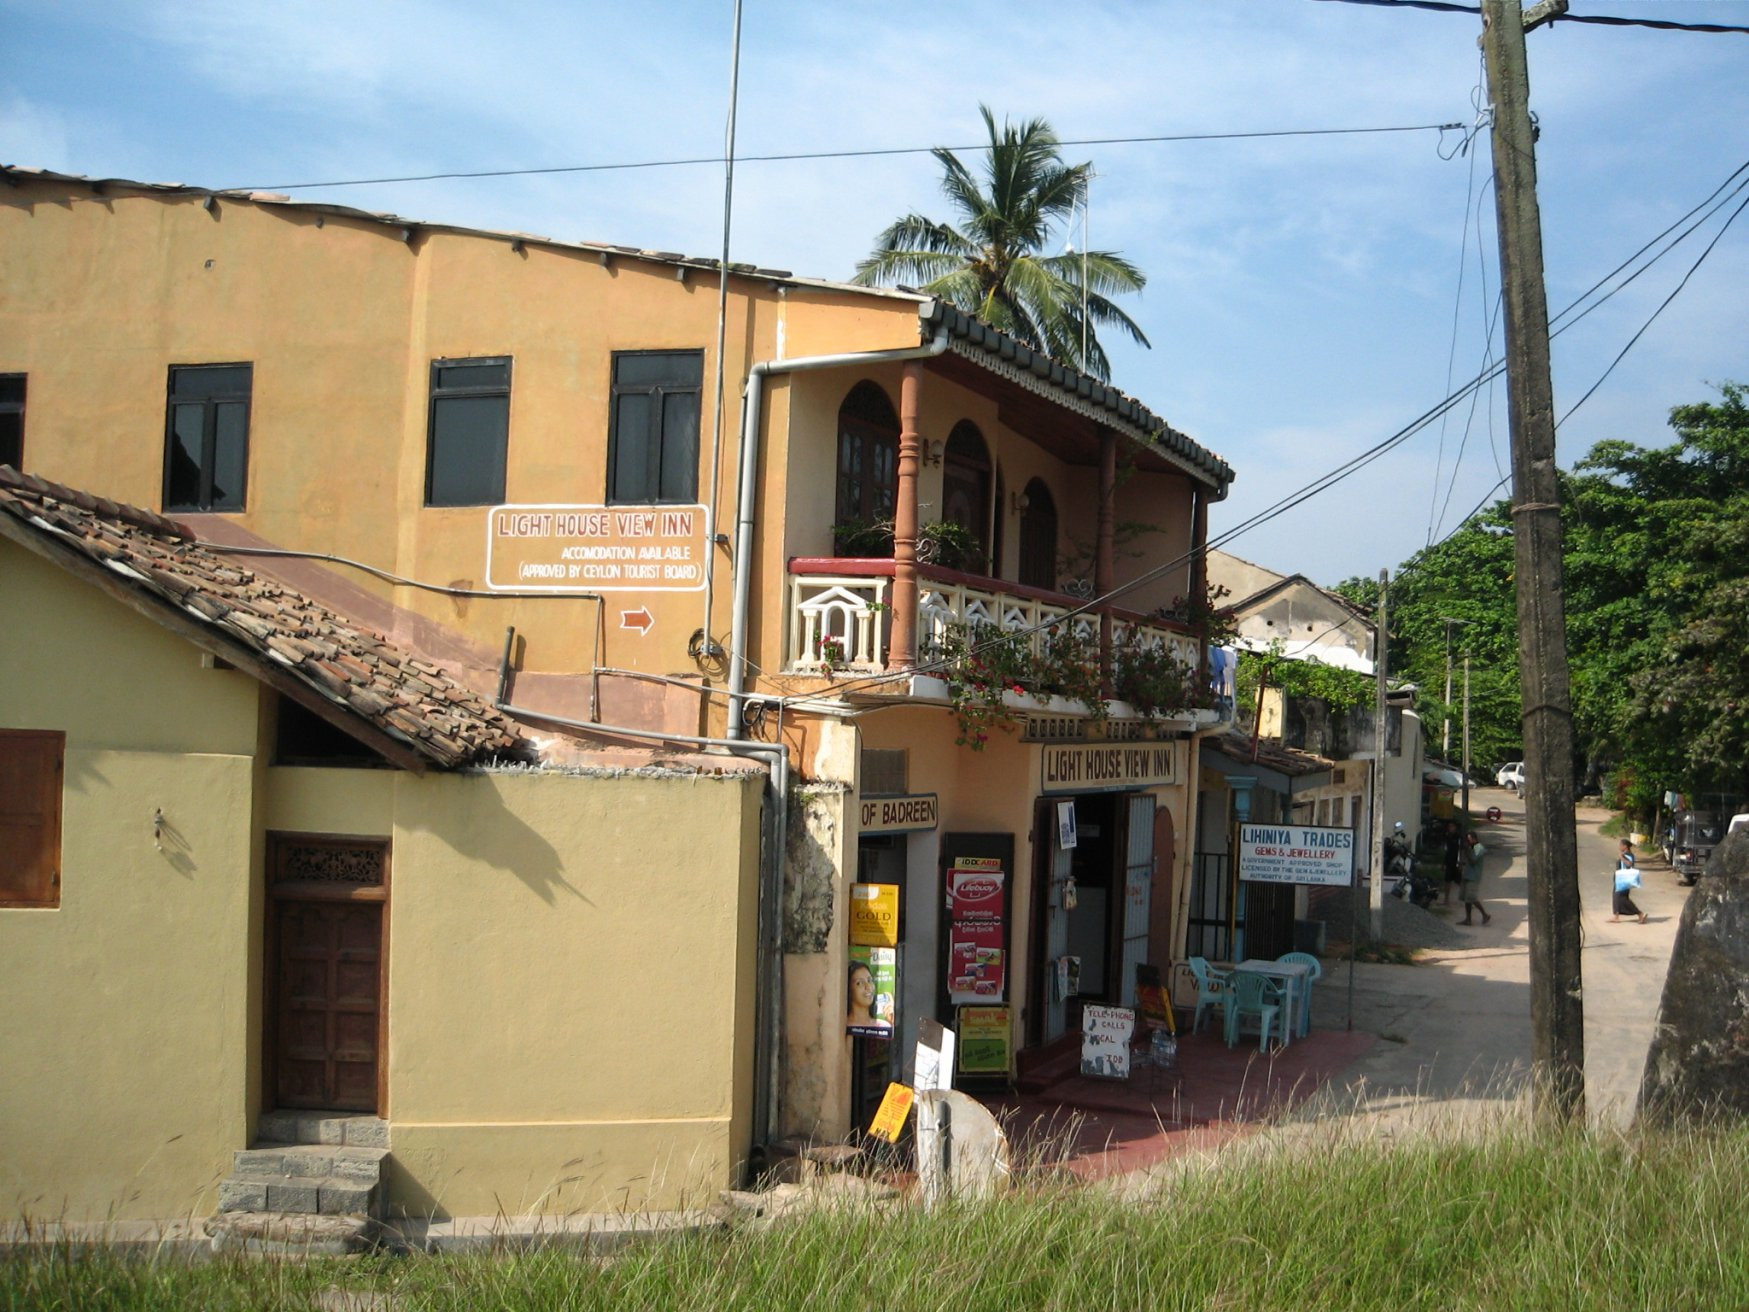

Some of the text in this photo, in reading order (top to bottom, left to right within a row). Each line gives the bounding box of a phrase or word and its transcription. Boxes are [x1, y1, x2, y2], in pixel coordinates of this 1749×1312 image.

[498, 512, 693, 537] LIGHT HOUSE VIEW INN
[561, 546, 690, 560] ACCOMODATION AVAILABLE
[518, 561, 703, 582] (APPROVED BY CEYLON TOURIST BOARD)
[1047, 749, 1171, 782] LIGHT HOUSE VIEW INN
[861, 800, 936, 826] OF BADREEN
[1242, 828, 1351, 848] LIHINIYA TRADES
[1255, 847, 1336, 859] GEMS & JEWELLERY
[856, 911, 892, 921] GOLD
[1101, 1021, 1125, 1030] CALLS
